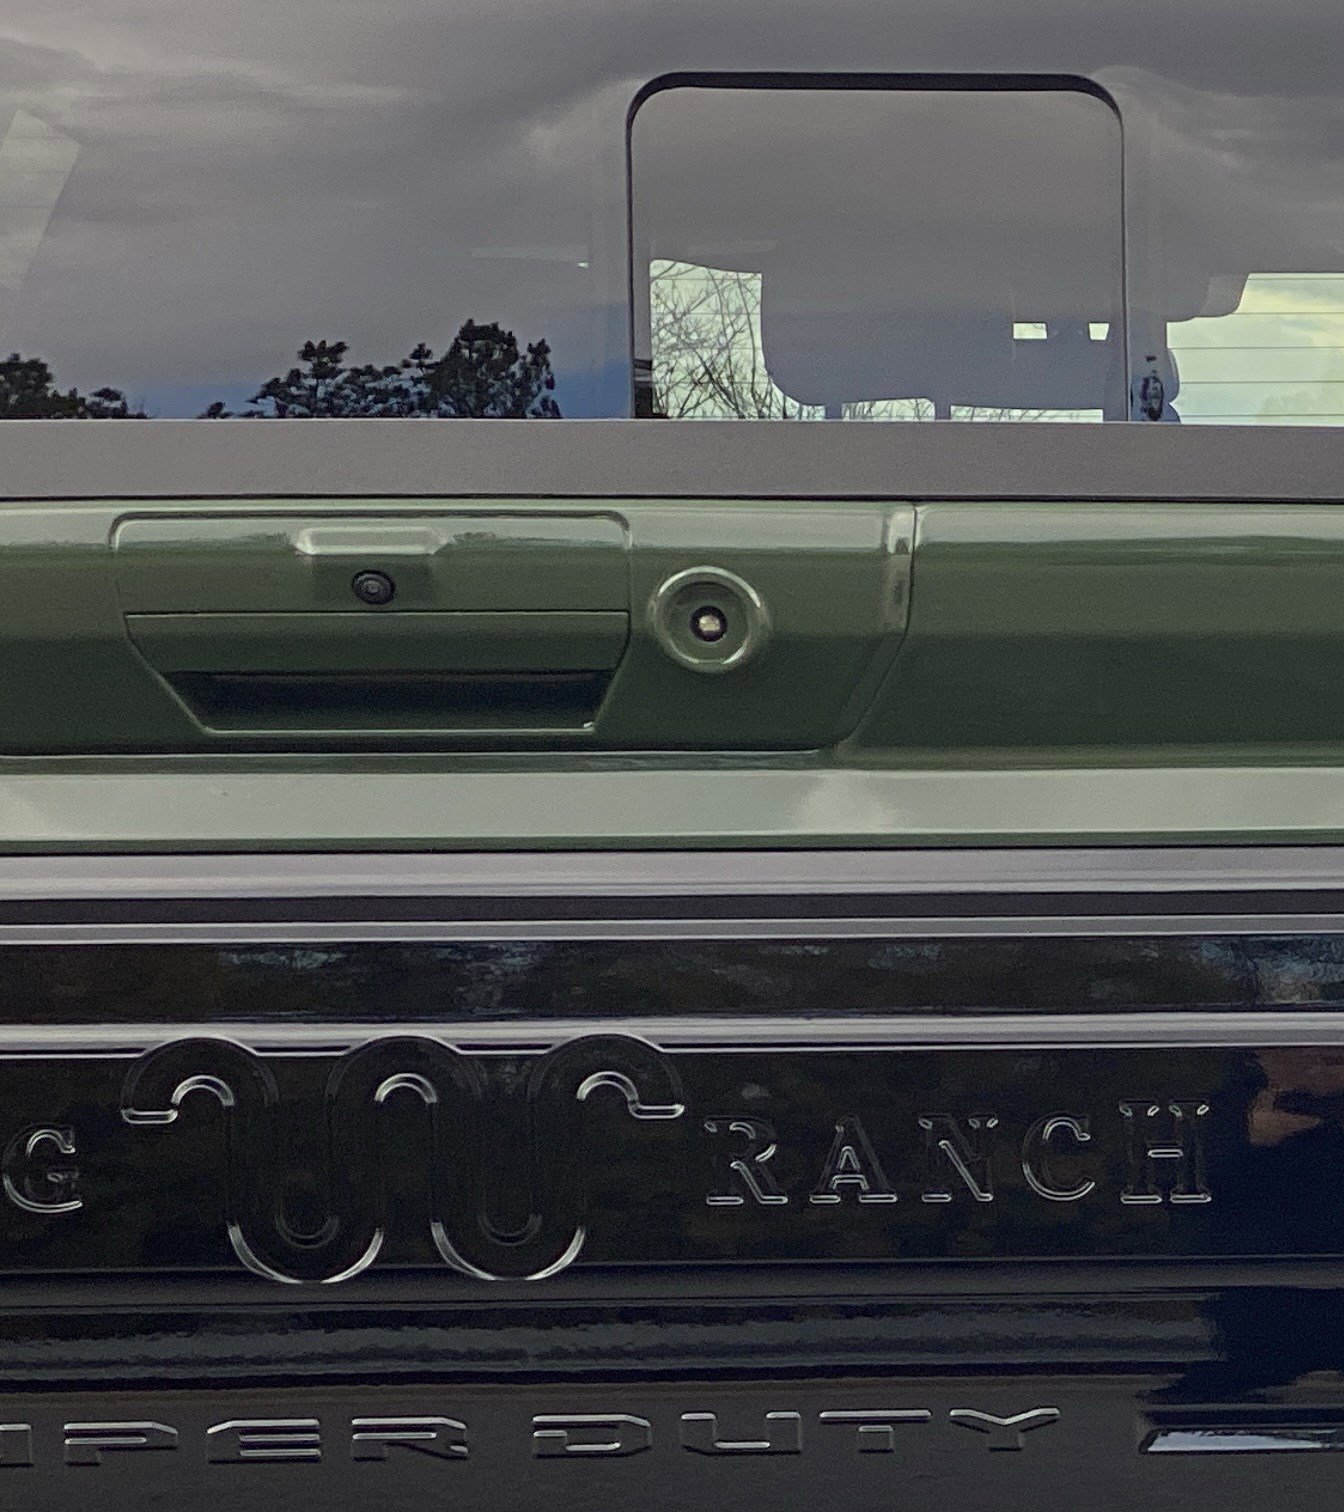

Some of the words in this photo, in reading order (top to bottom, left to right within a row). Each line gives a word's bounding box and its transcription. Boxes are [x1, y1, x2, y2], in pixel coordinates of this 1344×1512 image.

[703, 1101, 1212, 1205] RANCH
[0, 1416, 469, 1467] PER
[532, 1406, 1062, 1457] DUTY
